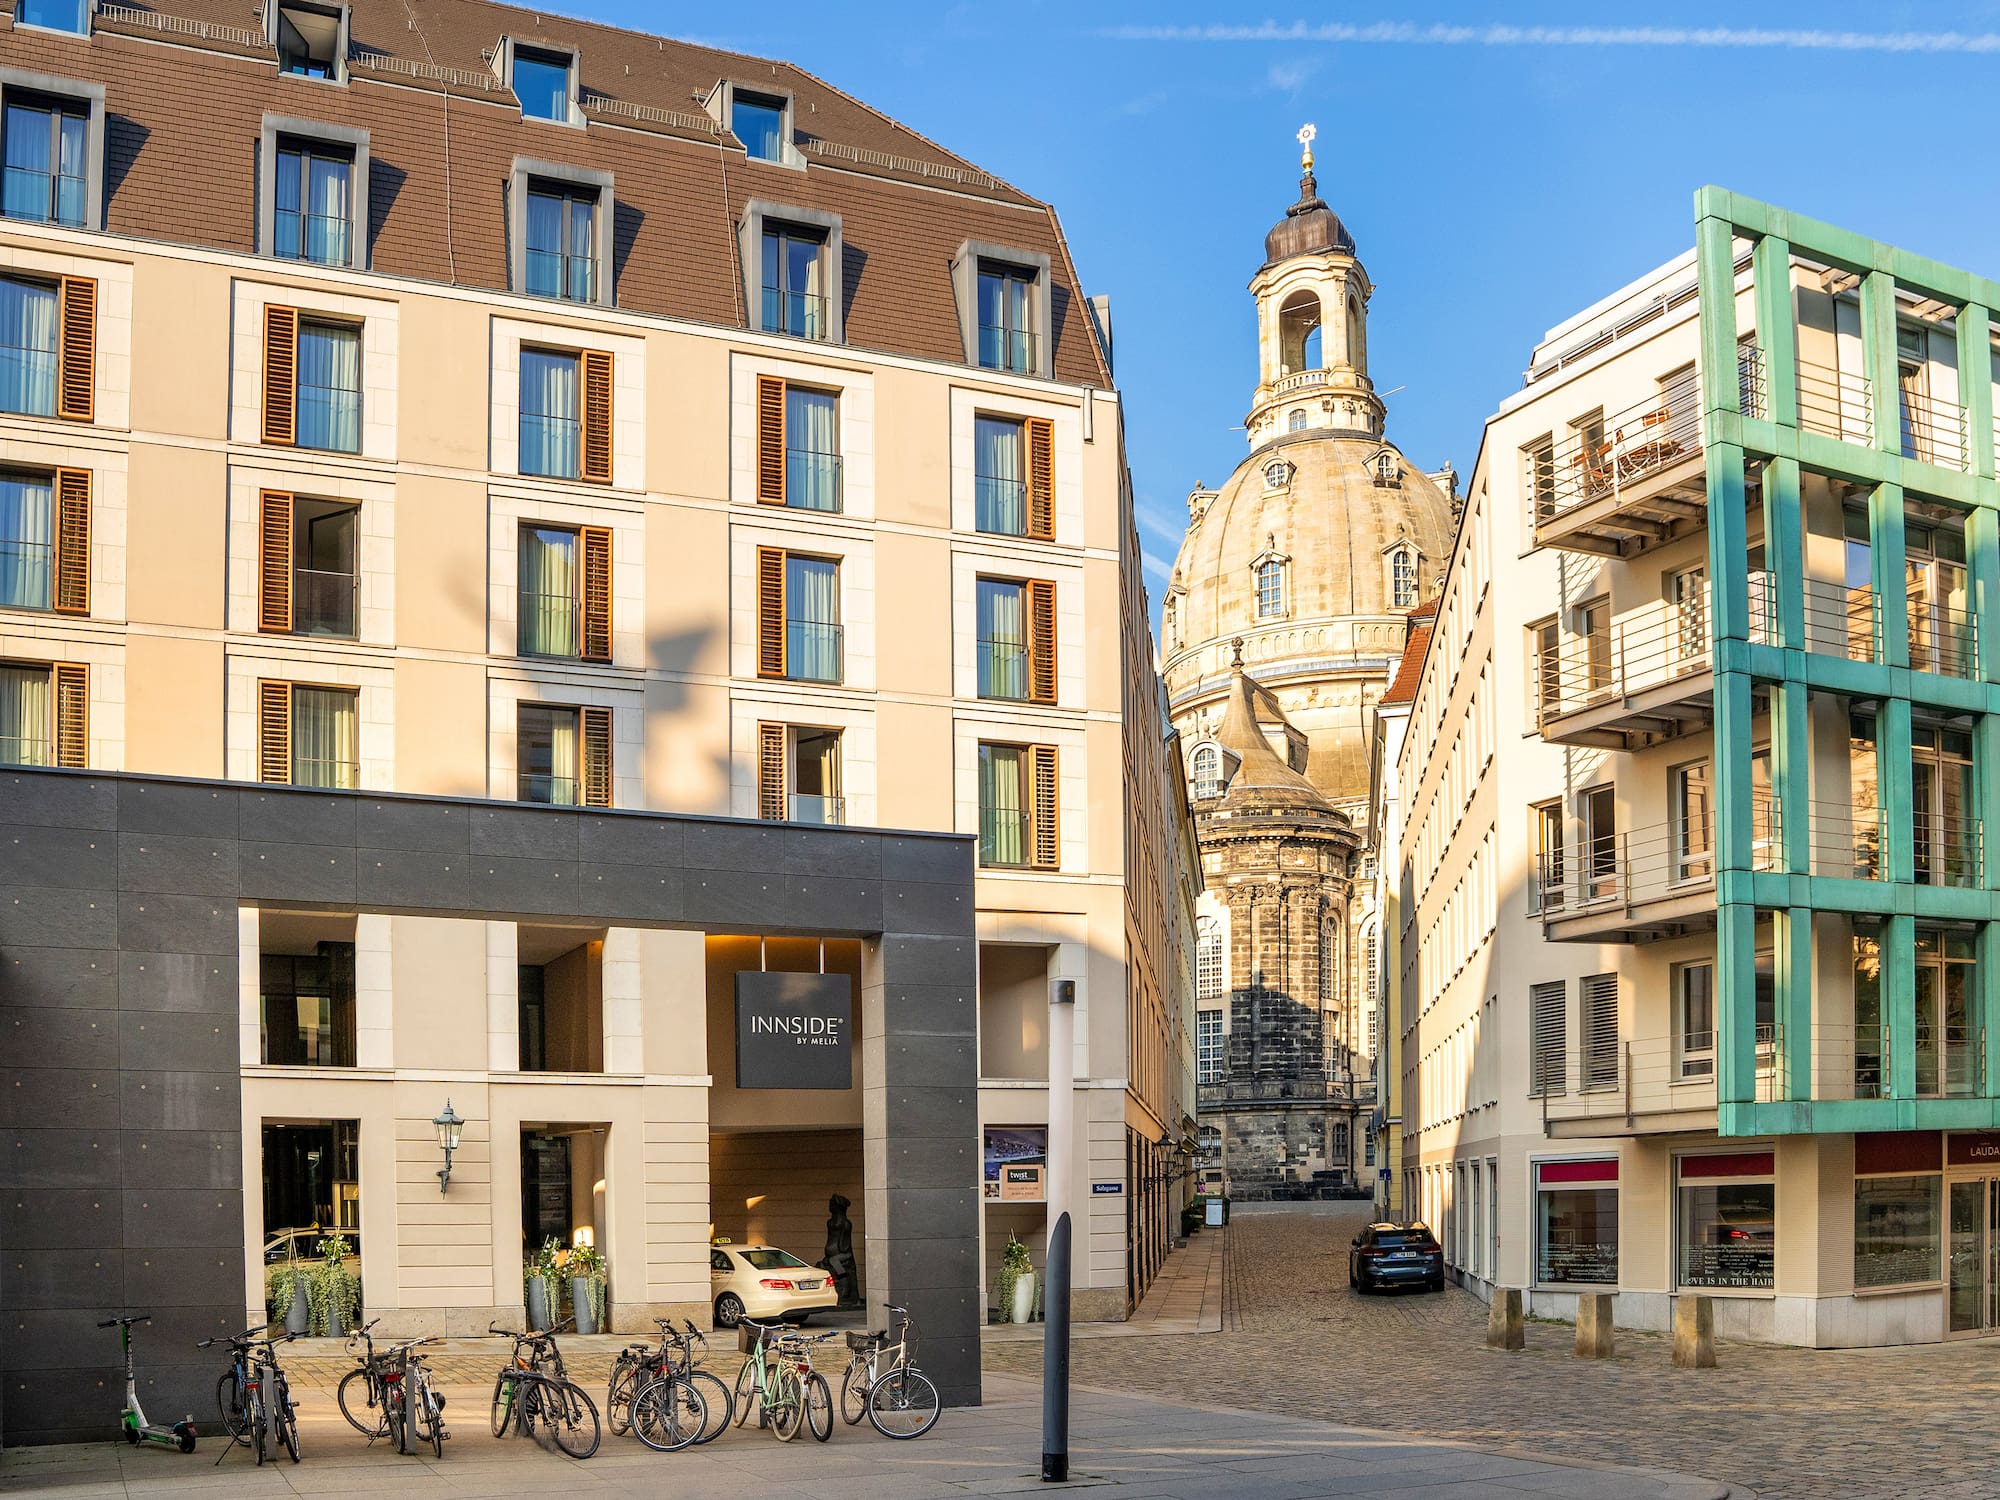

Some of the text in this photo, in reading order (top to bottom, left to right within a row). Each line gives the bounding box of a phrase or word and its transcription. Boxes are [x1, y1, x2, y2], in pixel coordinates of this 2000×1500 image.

[751, 1016, 838, 1035] INNSIDE
[797, 1037, 807, 1045] BY
[1010, 1171, 1028, 1179] twist
[1681, 1273, 1773, 1286] LOVE IS IN THE HAIR
